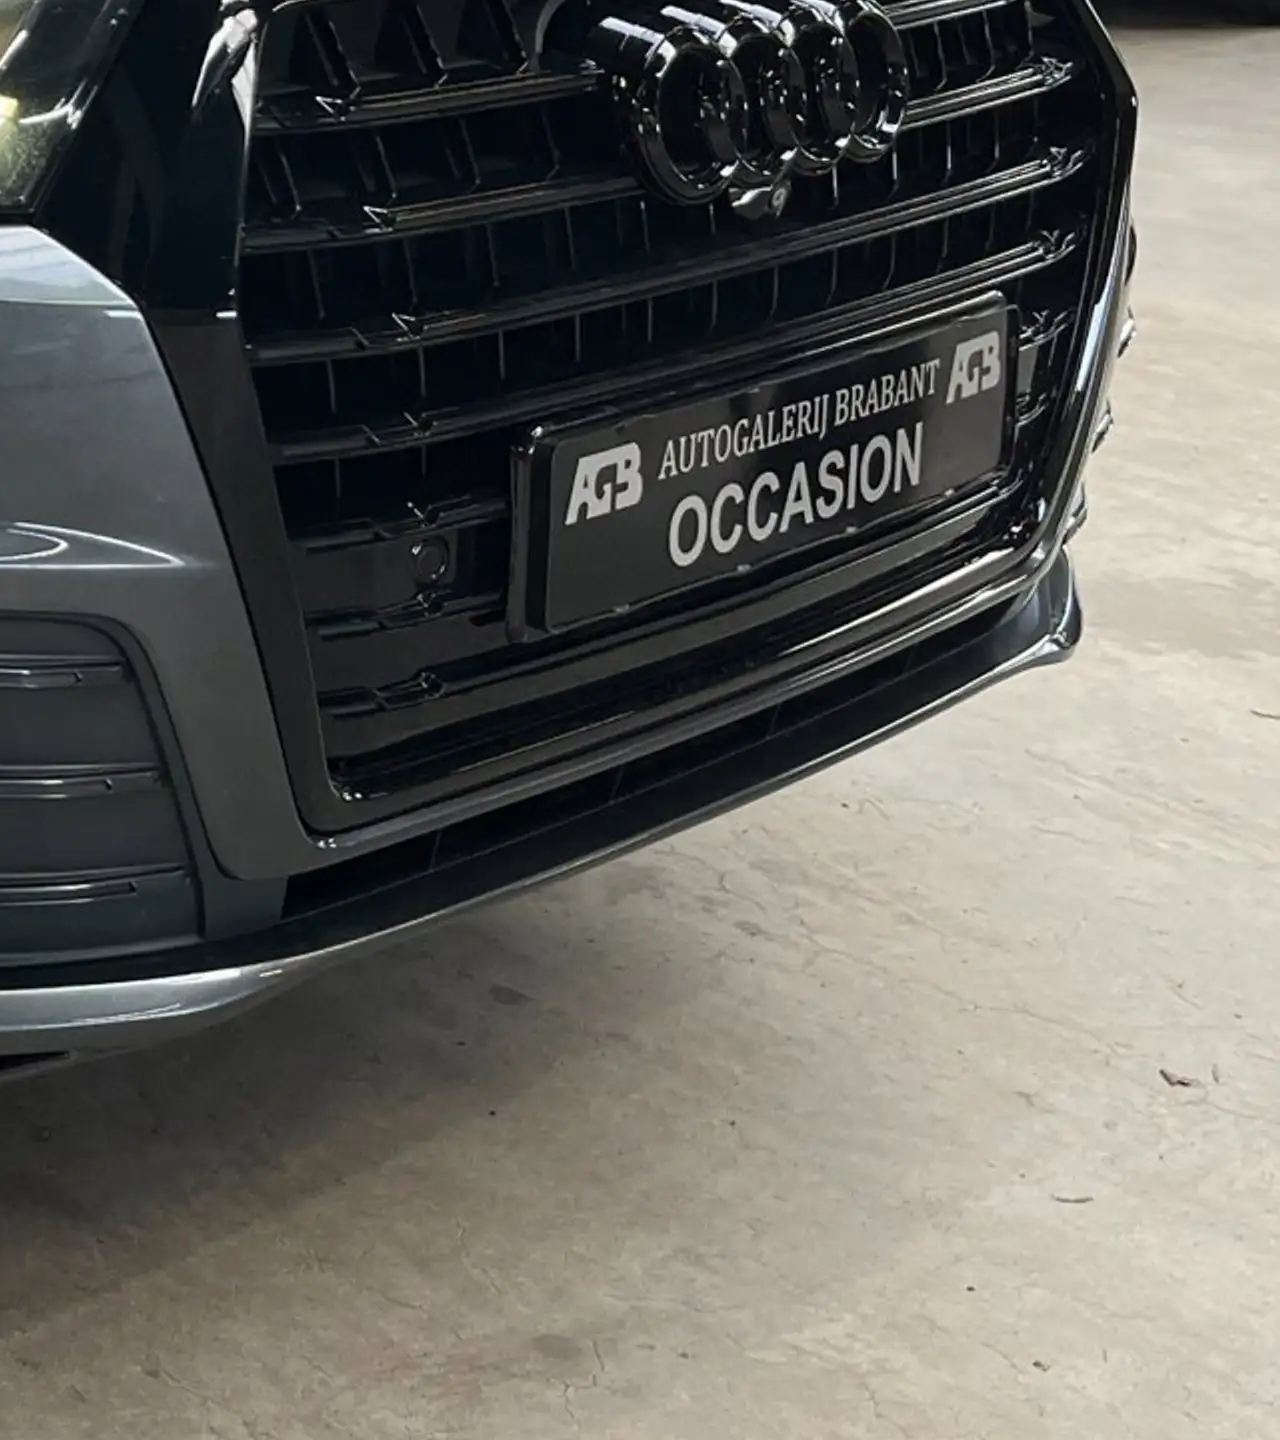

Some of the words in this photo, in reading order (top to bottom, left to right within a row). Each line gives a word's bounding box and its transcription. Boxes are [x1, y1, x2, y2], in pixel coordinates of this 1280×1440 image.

[945, 329, 1002, 405] AGB
[657, 394, 830, 480] AUTOGALERIJ
[834, 358, 940, 426] BRABANT
[565, 441, 643, 526] AGB
[669, 421, 923, 567] OCCASION
